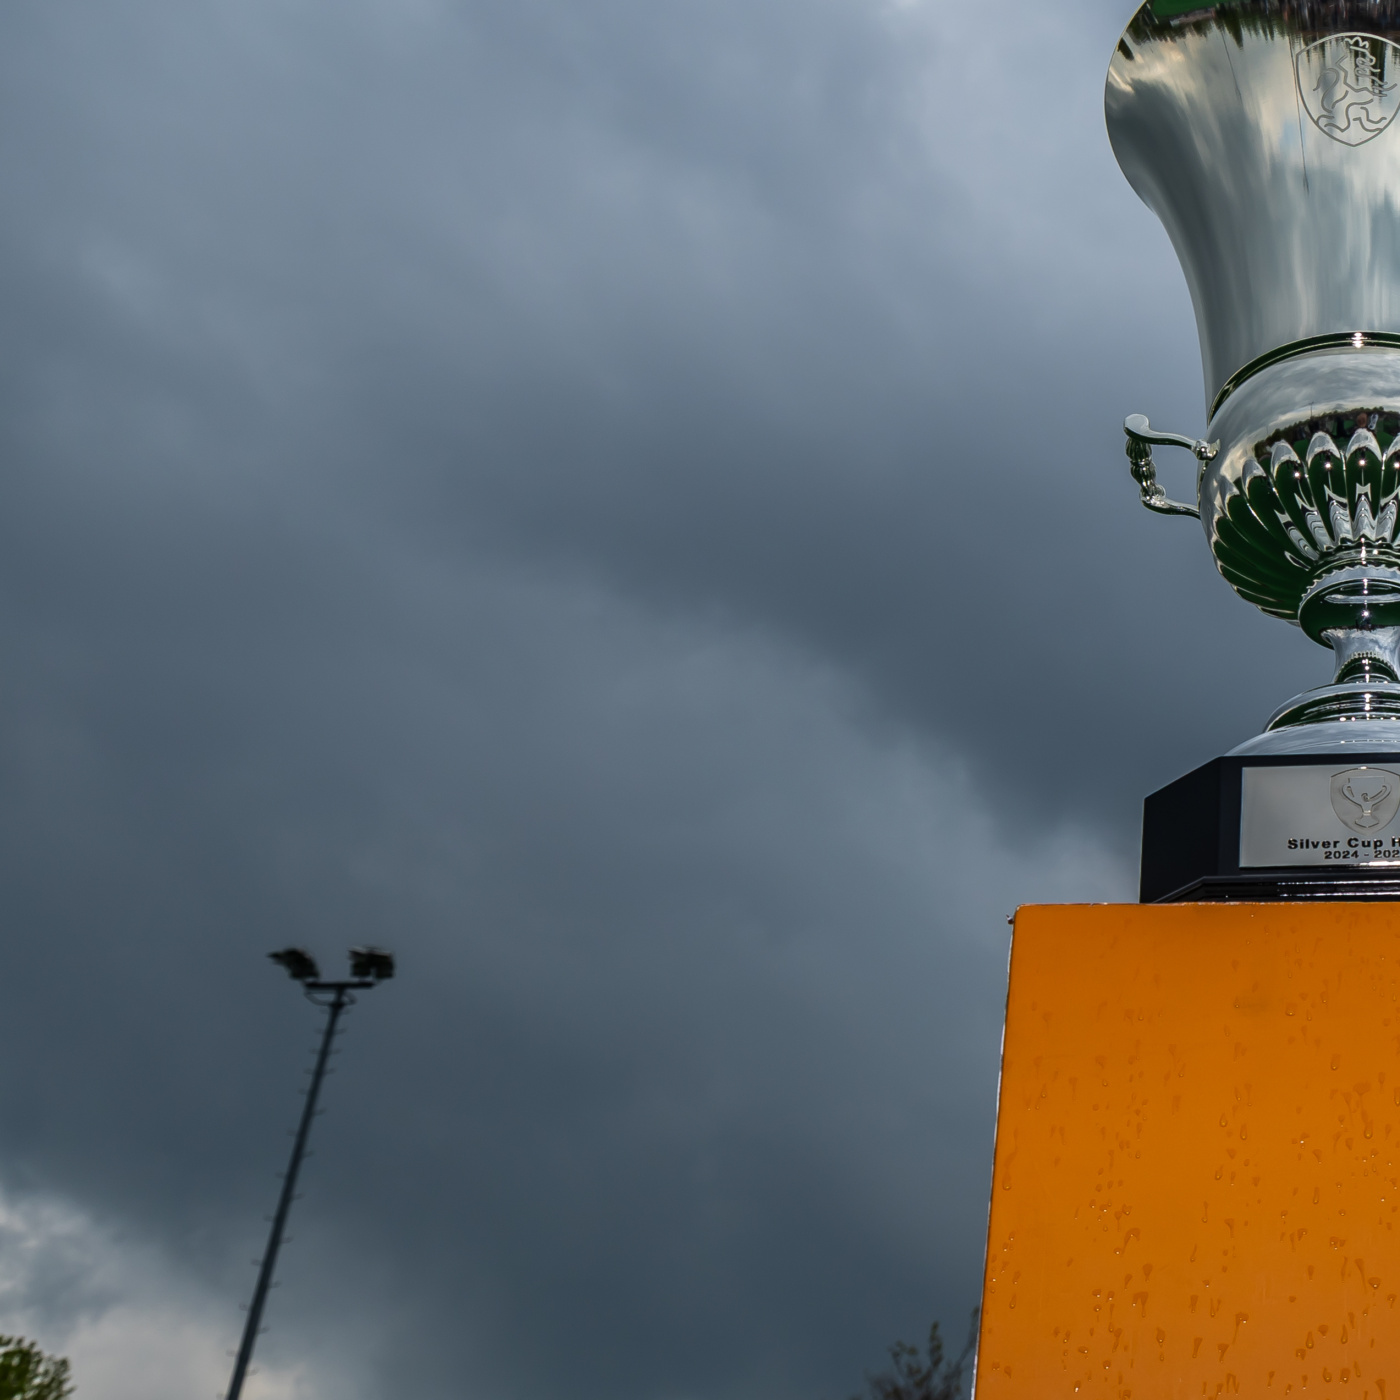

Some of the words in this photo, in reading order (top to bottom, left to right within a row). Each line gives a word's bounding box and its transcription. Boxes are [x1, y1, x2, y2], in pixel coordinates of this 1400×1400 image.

[1287, 838, 1340, 850] Silver
[1347, 837, 1384, 849] Cup
[1324, 850, 1359, 859] 2024
